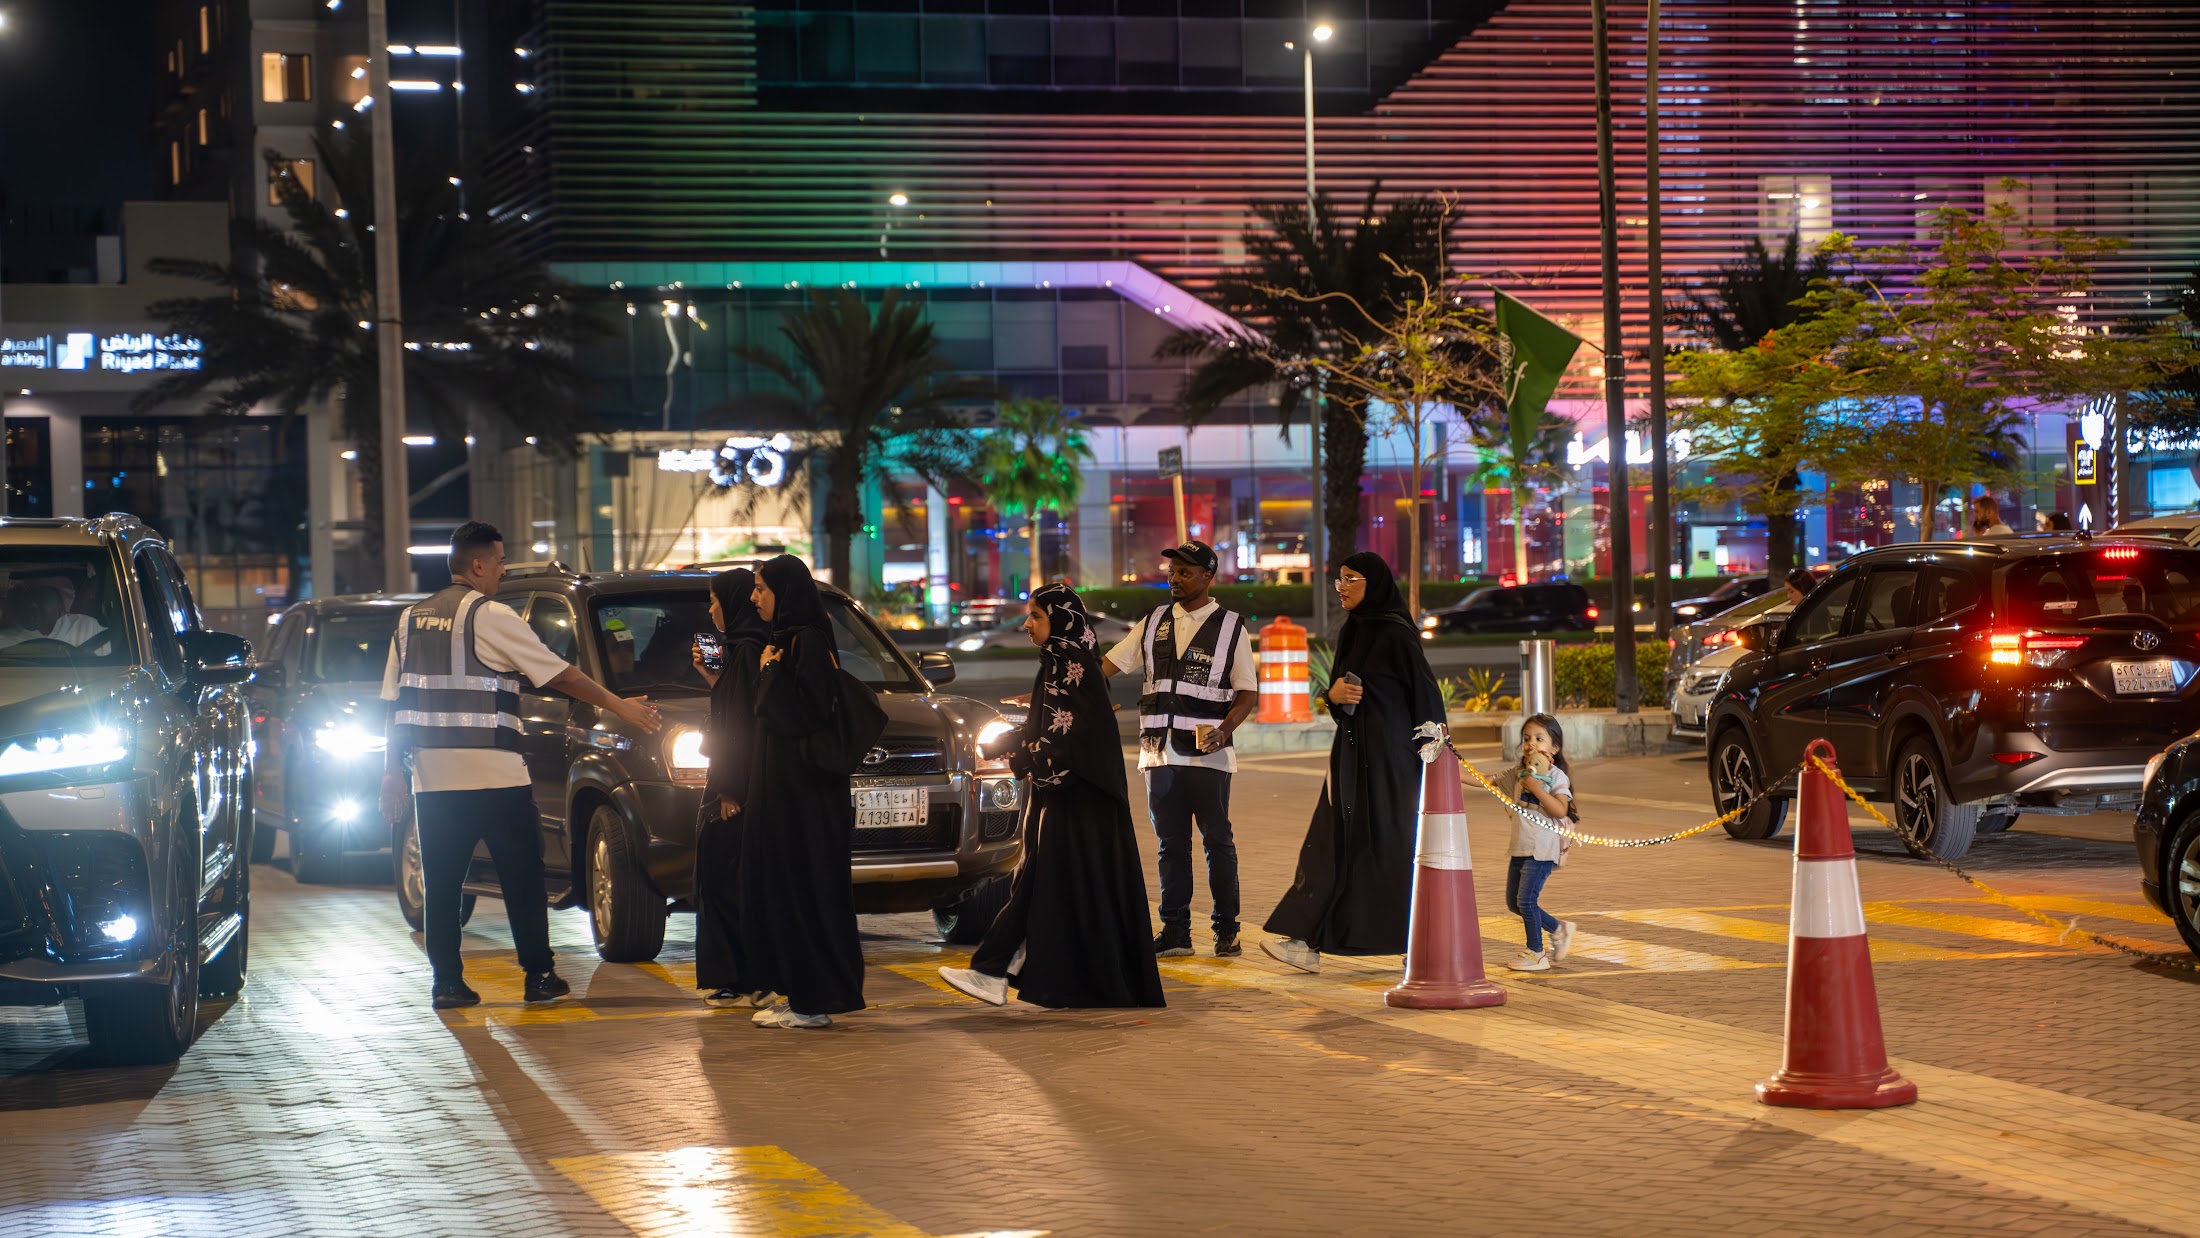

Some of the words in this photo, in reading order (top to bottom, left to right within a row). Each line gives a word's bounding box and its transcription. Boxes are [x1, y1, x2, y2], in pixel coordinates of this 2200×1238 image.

[101, 333, 153, 353] الرياض
[101, 352, 153, 373] Riyad
[416, 616, 453, 632] VPM
[2119, 679, 2146, 691] 5224
[859, 811, 890, 826] 4139
[893, 812, 914, 823] ETA
